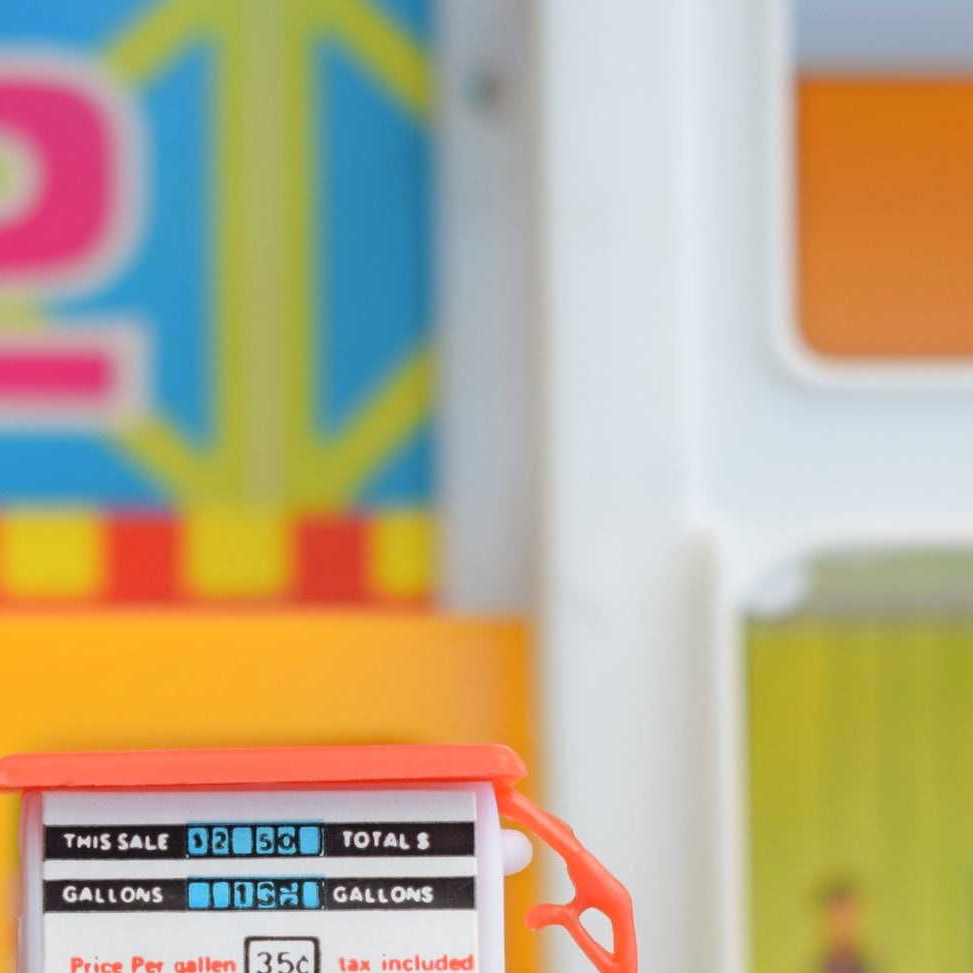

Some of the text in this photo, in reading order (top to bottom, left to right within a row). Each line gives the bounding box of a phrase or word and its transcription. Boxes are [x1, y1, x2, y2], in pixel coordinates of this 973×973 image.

[63, 833, 113, 851] THIS
[117, 833, 169, 852] SALE
[343, 830, 409, 849] TOTAL
[62, 886, 164, 903] GALLONS
[333, 885, 434, 903] GALLONS
[131, 956, 164, 973] Per
[339, 956, 371, 972] tax
[382, 953, 475, 972] included
